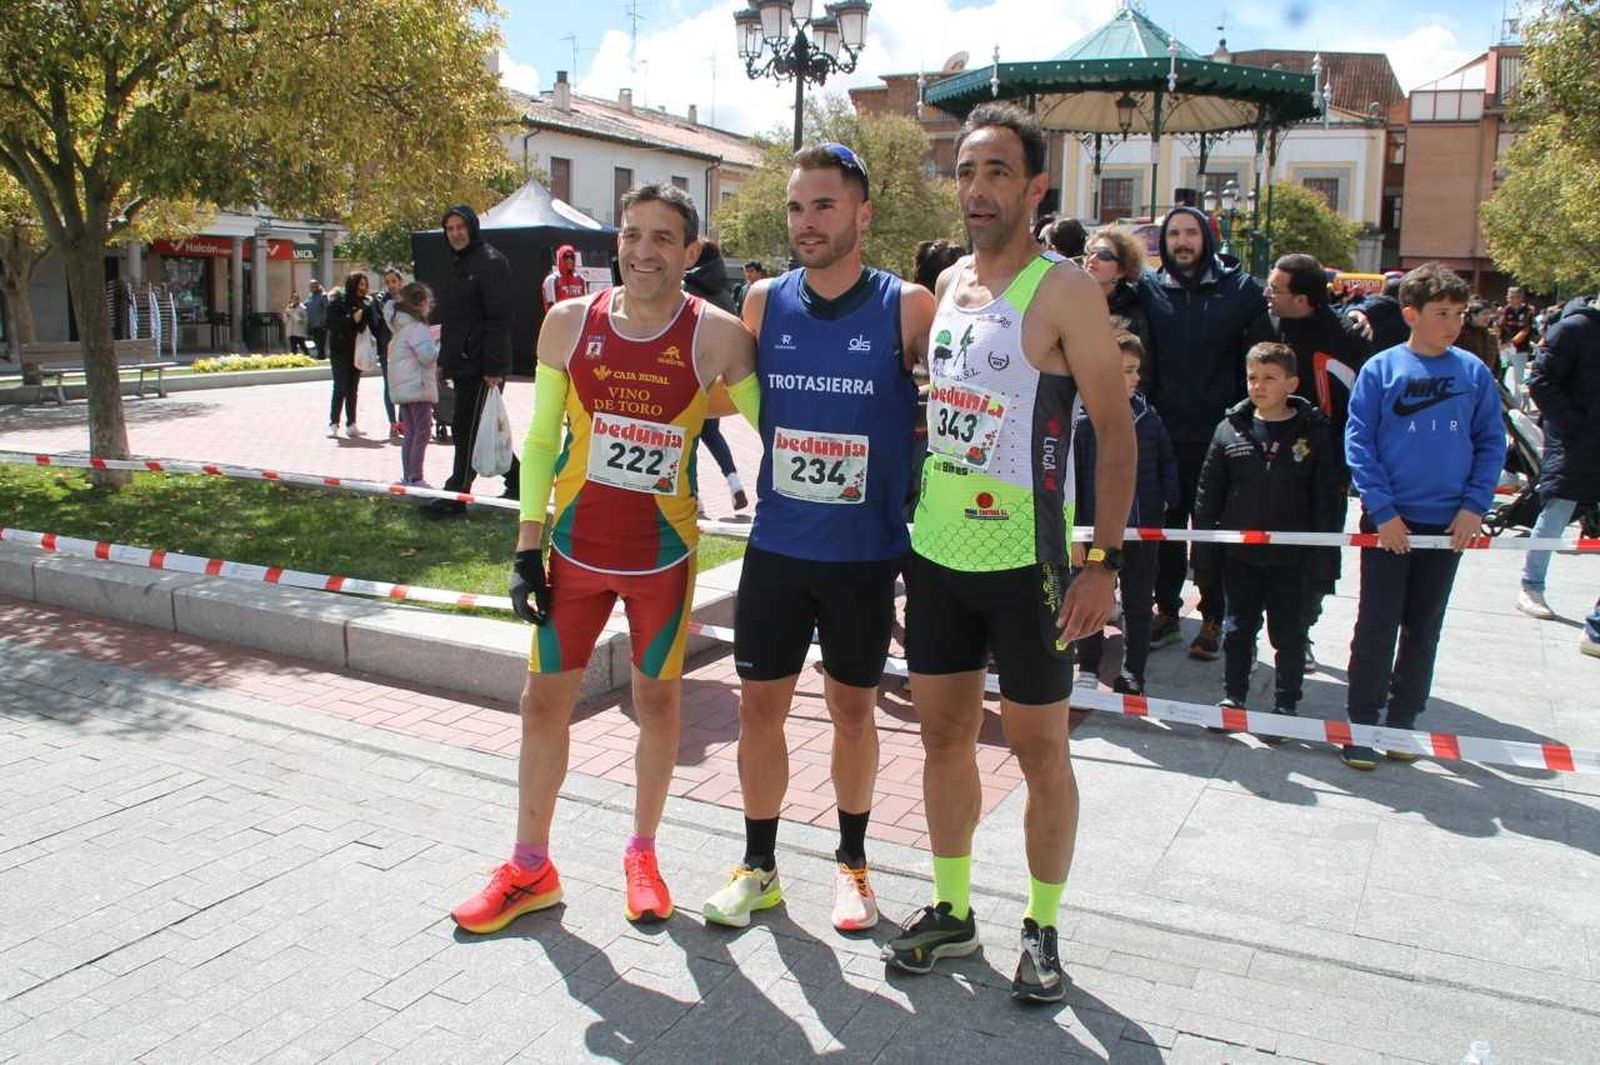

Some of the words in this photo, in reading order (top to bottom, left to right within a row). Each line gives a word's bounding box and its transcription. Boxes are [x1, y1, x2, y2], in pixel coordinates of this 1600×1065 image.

[639, 373, 670, 384] RURAL
[767, 373, 875, 395] TROTASIERRA
[1403, 376, 1457, 398] NIKE
[609, 387, 651, 401] VINO
[593, 398, 614, 411] DE
[618, 400, 663, 417] TORO
[937, 408, 977, 443] 343
[607, 442, 664, 475] 222
[791, 456, 846, 485] 234
